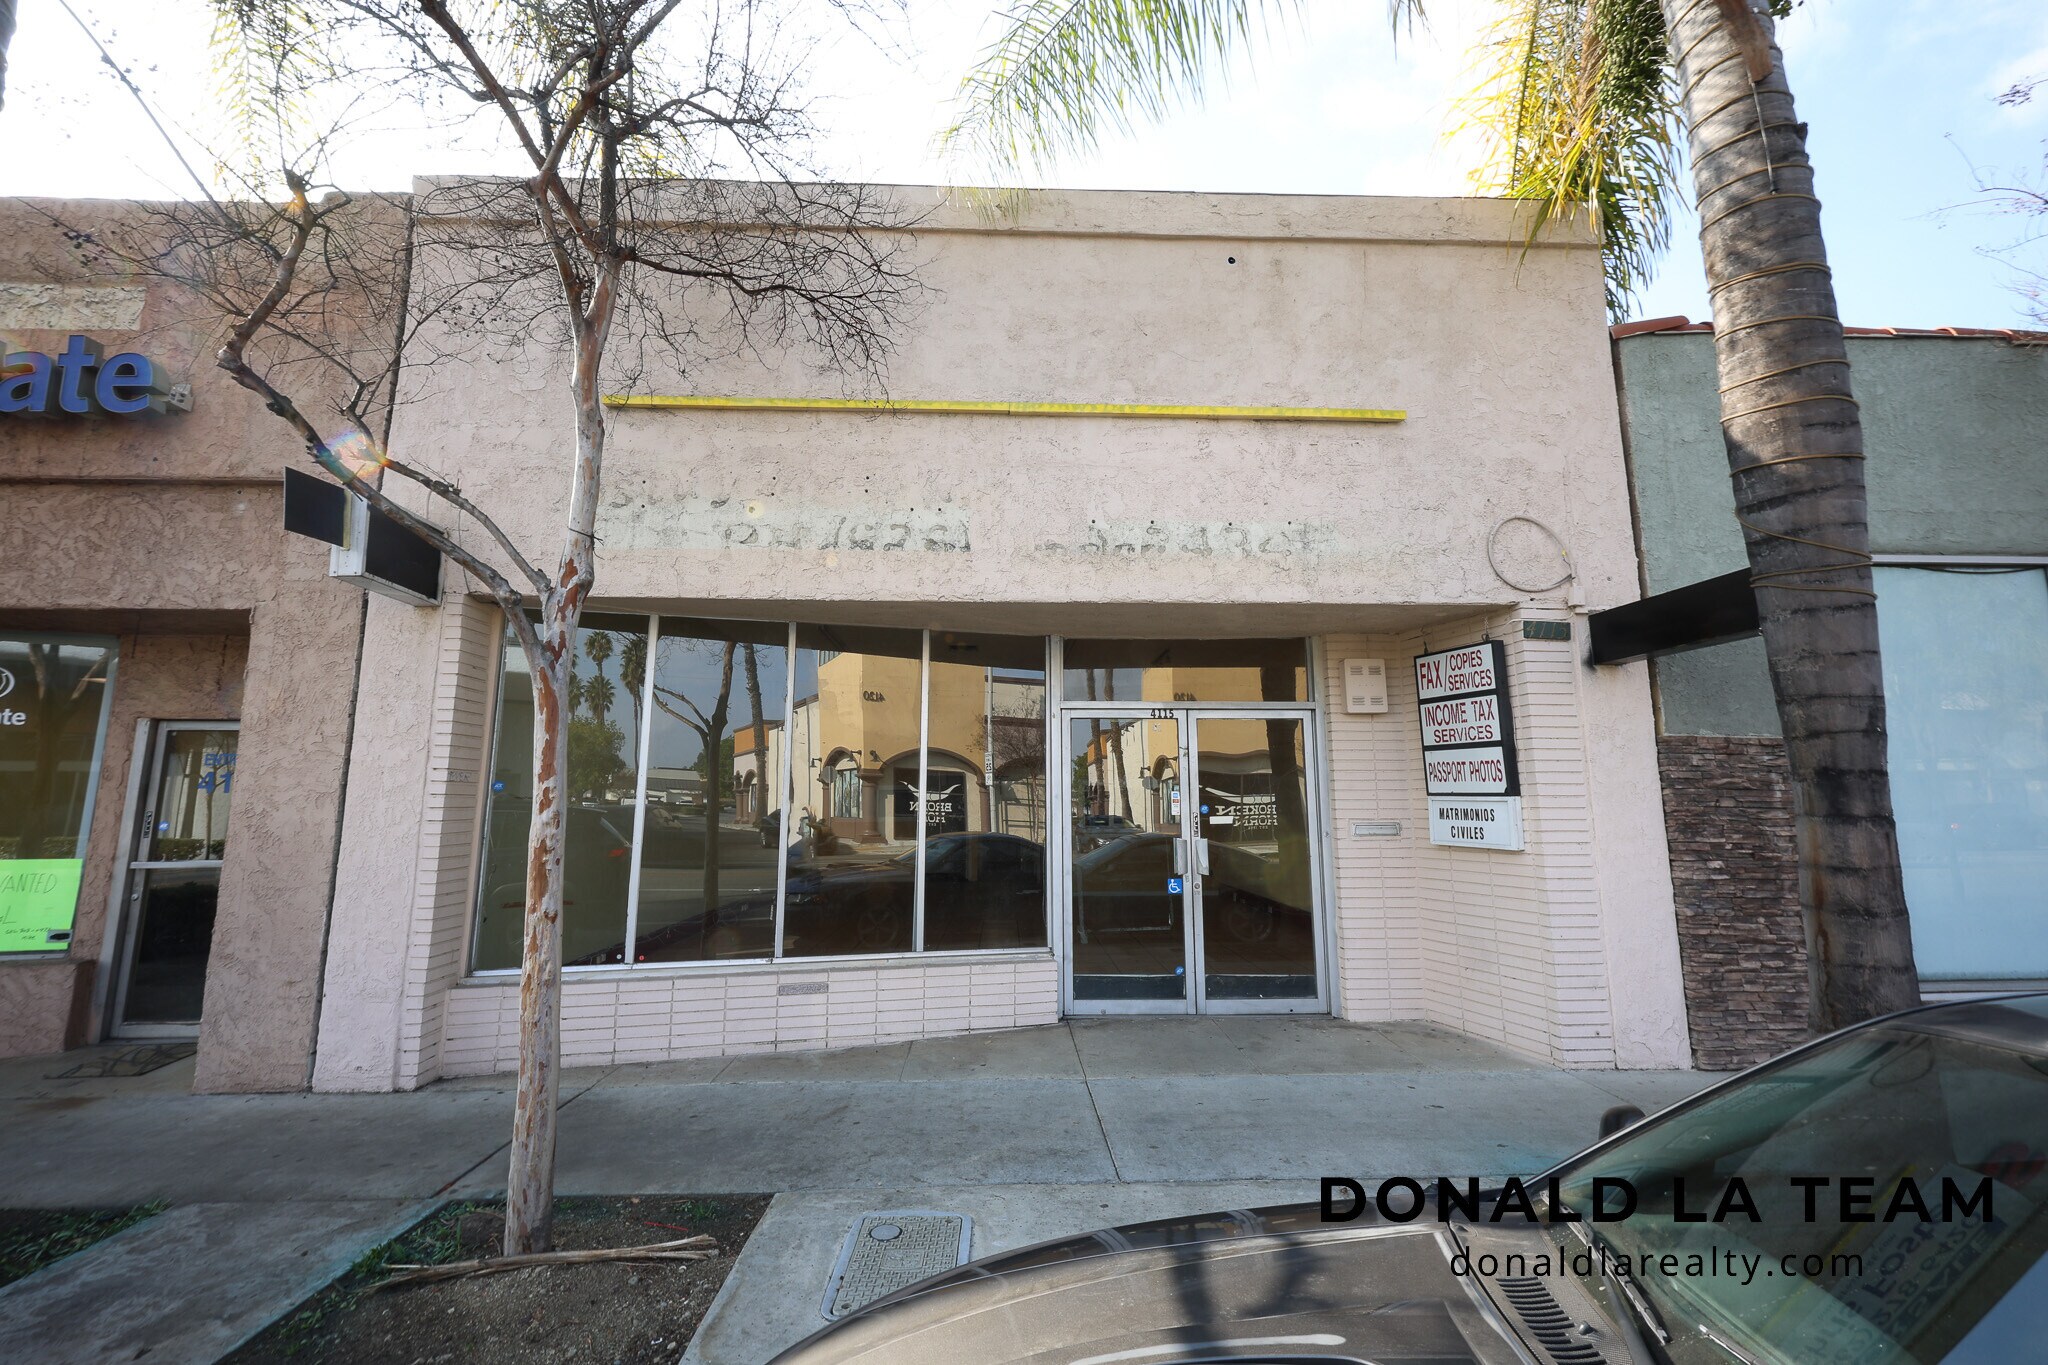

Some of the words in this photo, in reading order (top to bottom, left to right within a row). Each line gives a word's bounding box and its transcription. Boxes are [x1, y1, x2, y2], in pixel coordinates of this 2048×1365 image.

[1525, 622, 1568, 639] 4115
[1450, 650, 1483, 671] COPIES
[1448, 669, 1493, 692] SERVICES
[1150, 709, 1174, 719] 4115
[1424, 702, 1468, 727] INCOME
[1471, 699, 1495, 722] TAX
[1433, 725, 1494, 744] SERVICES
[1428, 761, 1467, 783] PASSPORT
[1469, 759, 1503, 783] PHOTOS
[1439, 807, 1495, 822] MATRIMONIOS
[1450, 825, 1485, 840] CIVILES
